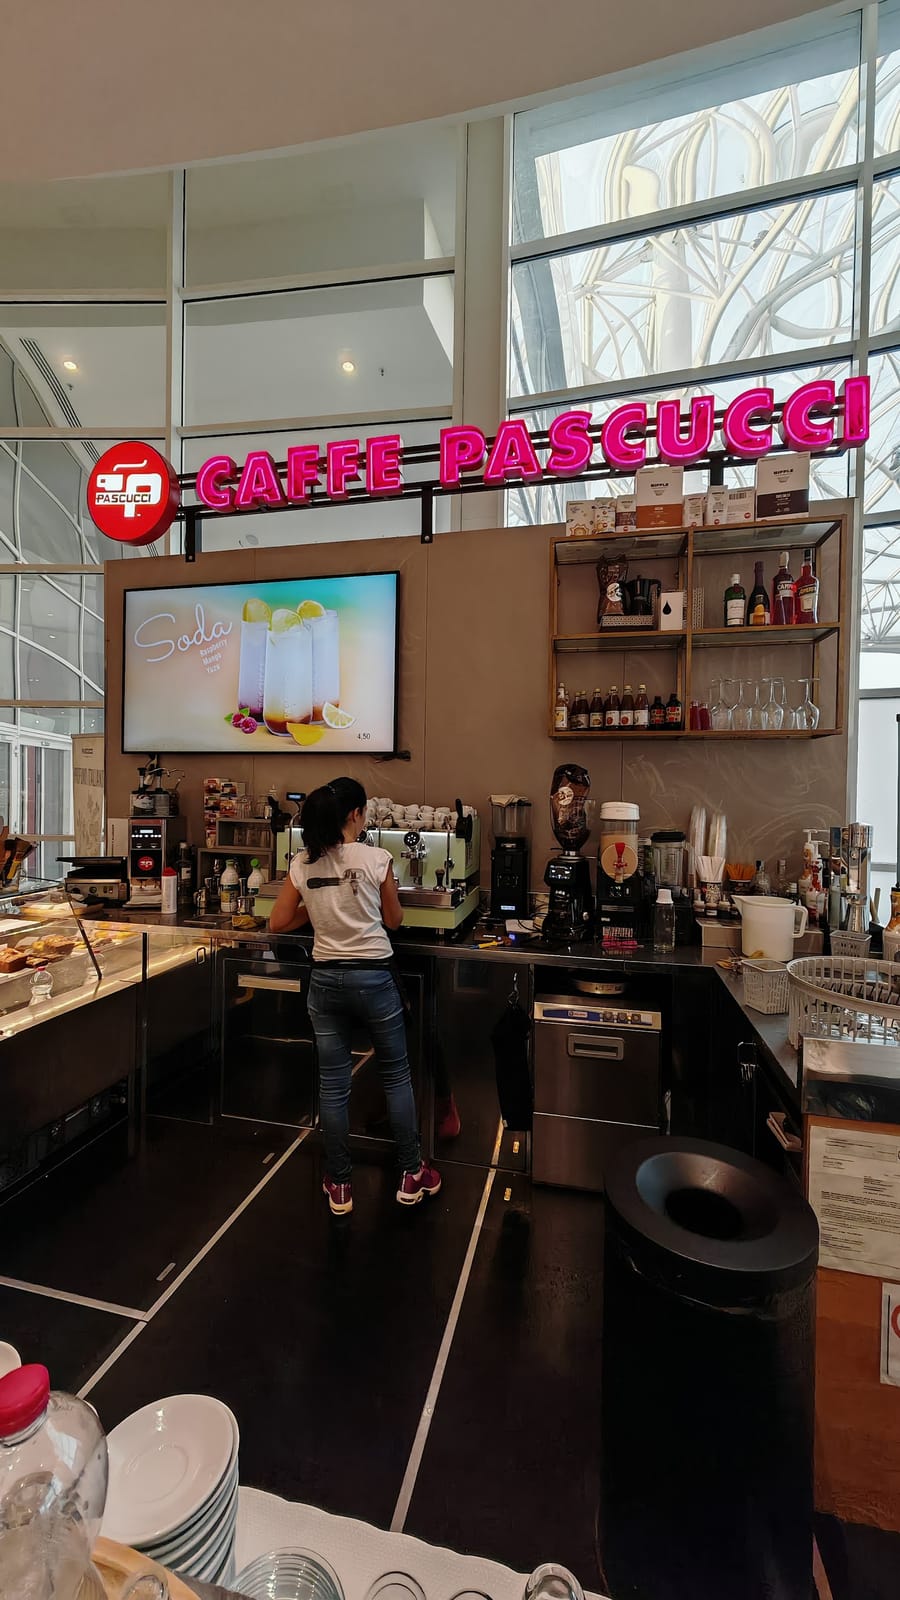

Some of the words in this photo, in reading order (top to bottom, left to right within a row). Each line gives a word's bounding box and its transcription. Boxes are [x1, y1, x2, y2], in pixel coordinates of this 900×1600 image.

[195, 435, 402, 513] CAFFE
[440, 375, 871, 488] PASCUCCI
[95, 494, 151, 503] PASCUCCI
[134, 603, 233, 662] Soda
